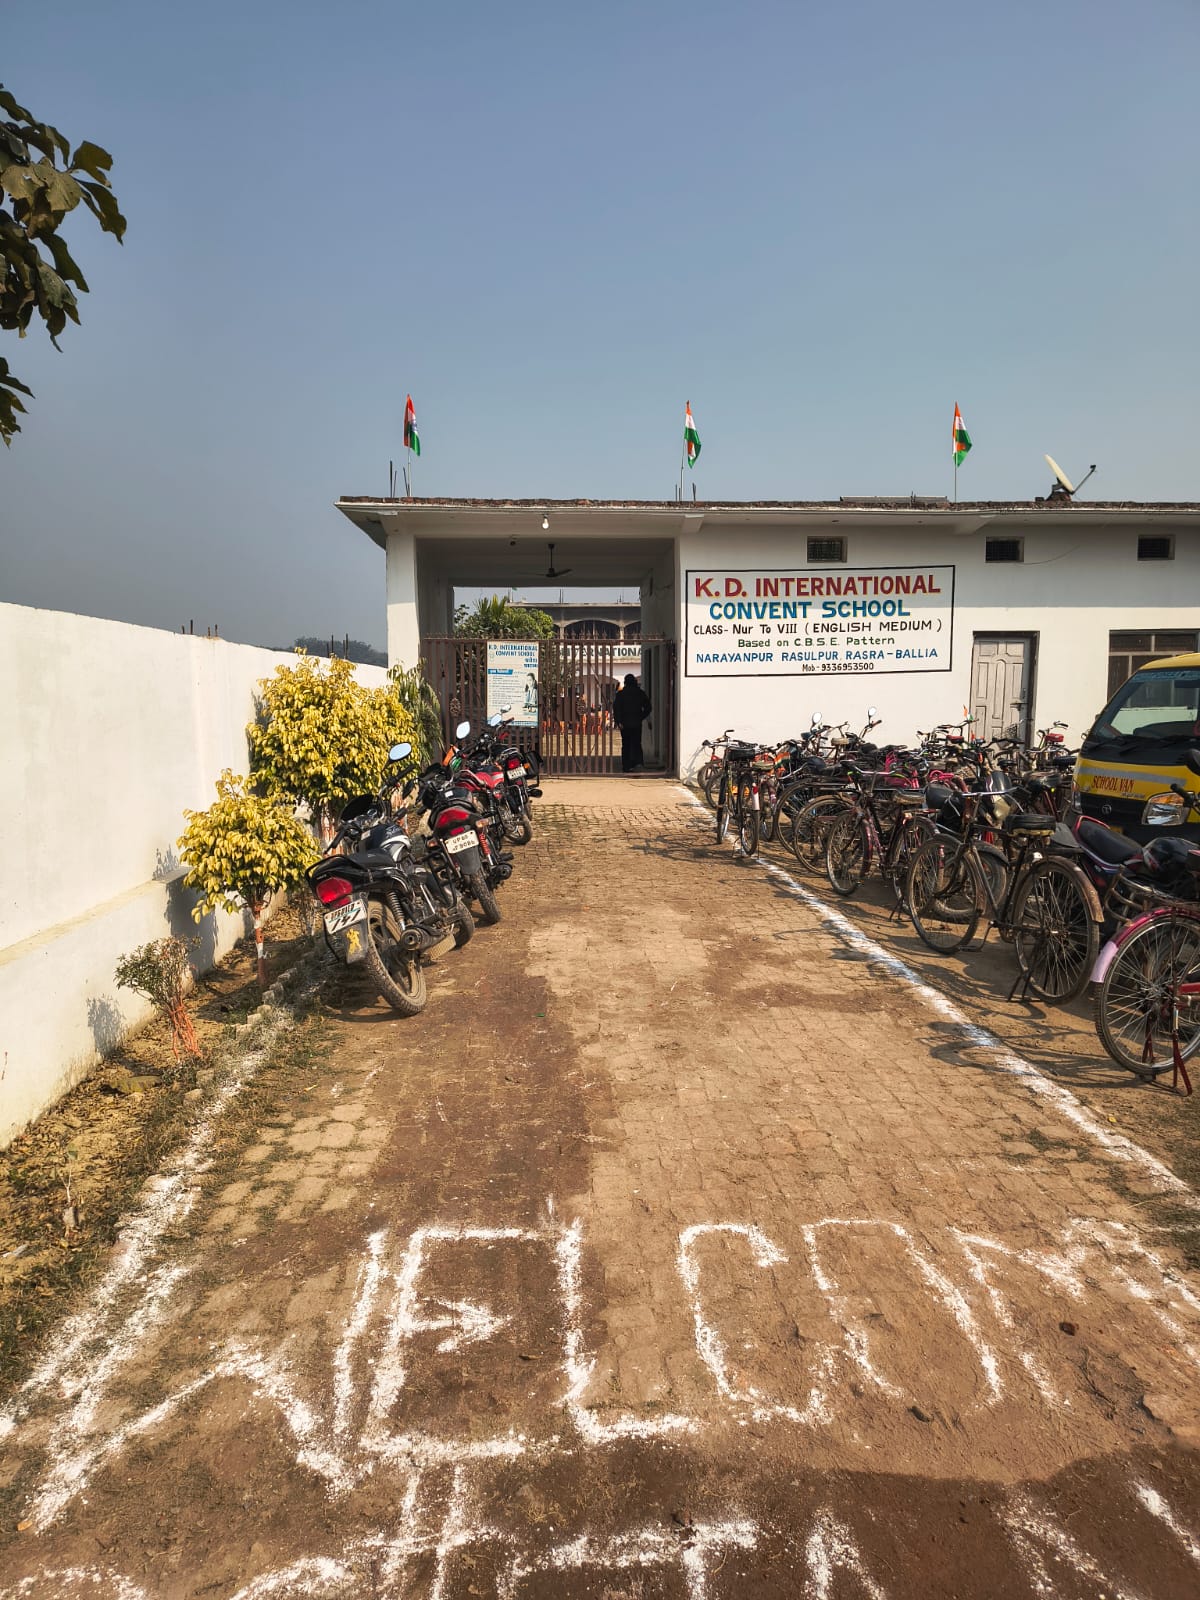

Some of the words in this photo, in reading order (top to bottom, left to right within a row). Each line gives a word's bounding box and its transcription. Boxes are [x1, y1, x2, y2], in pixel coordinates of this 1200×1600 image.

[755, 574, 941, 597] INTERNATIONAL
[709, 601, 812, 620] CONVENT
[821, 599, 911, 619] SCHOOL
[732, 624, 754, 634] Nur
[759, 624, 771, 634] To
[777, 623, 798, 634] VIII
[738, 639, 771, 648] Based
[846, 636, 895, 646] Pattern
[696, 652, 774, 663] NARAYANPUR
[1091, 775, 1118, 791] SCHOOL
[1119, 777, 1136, 793] VAN
